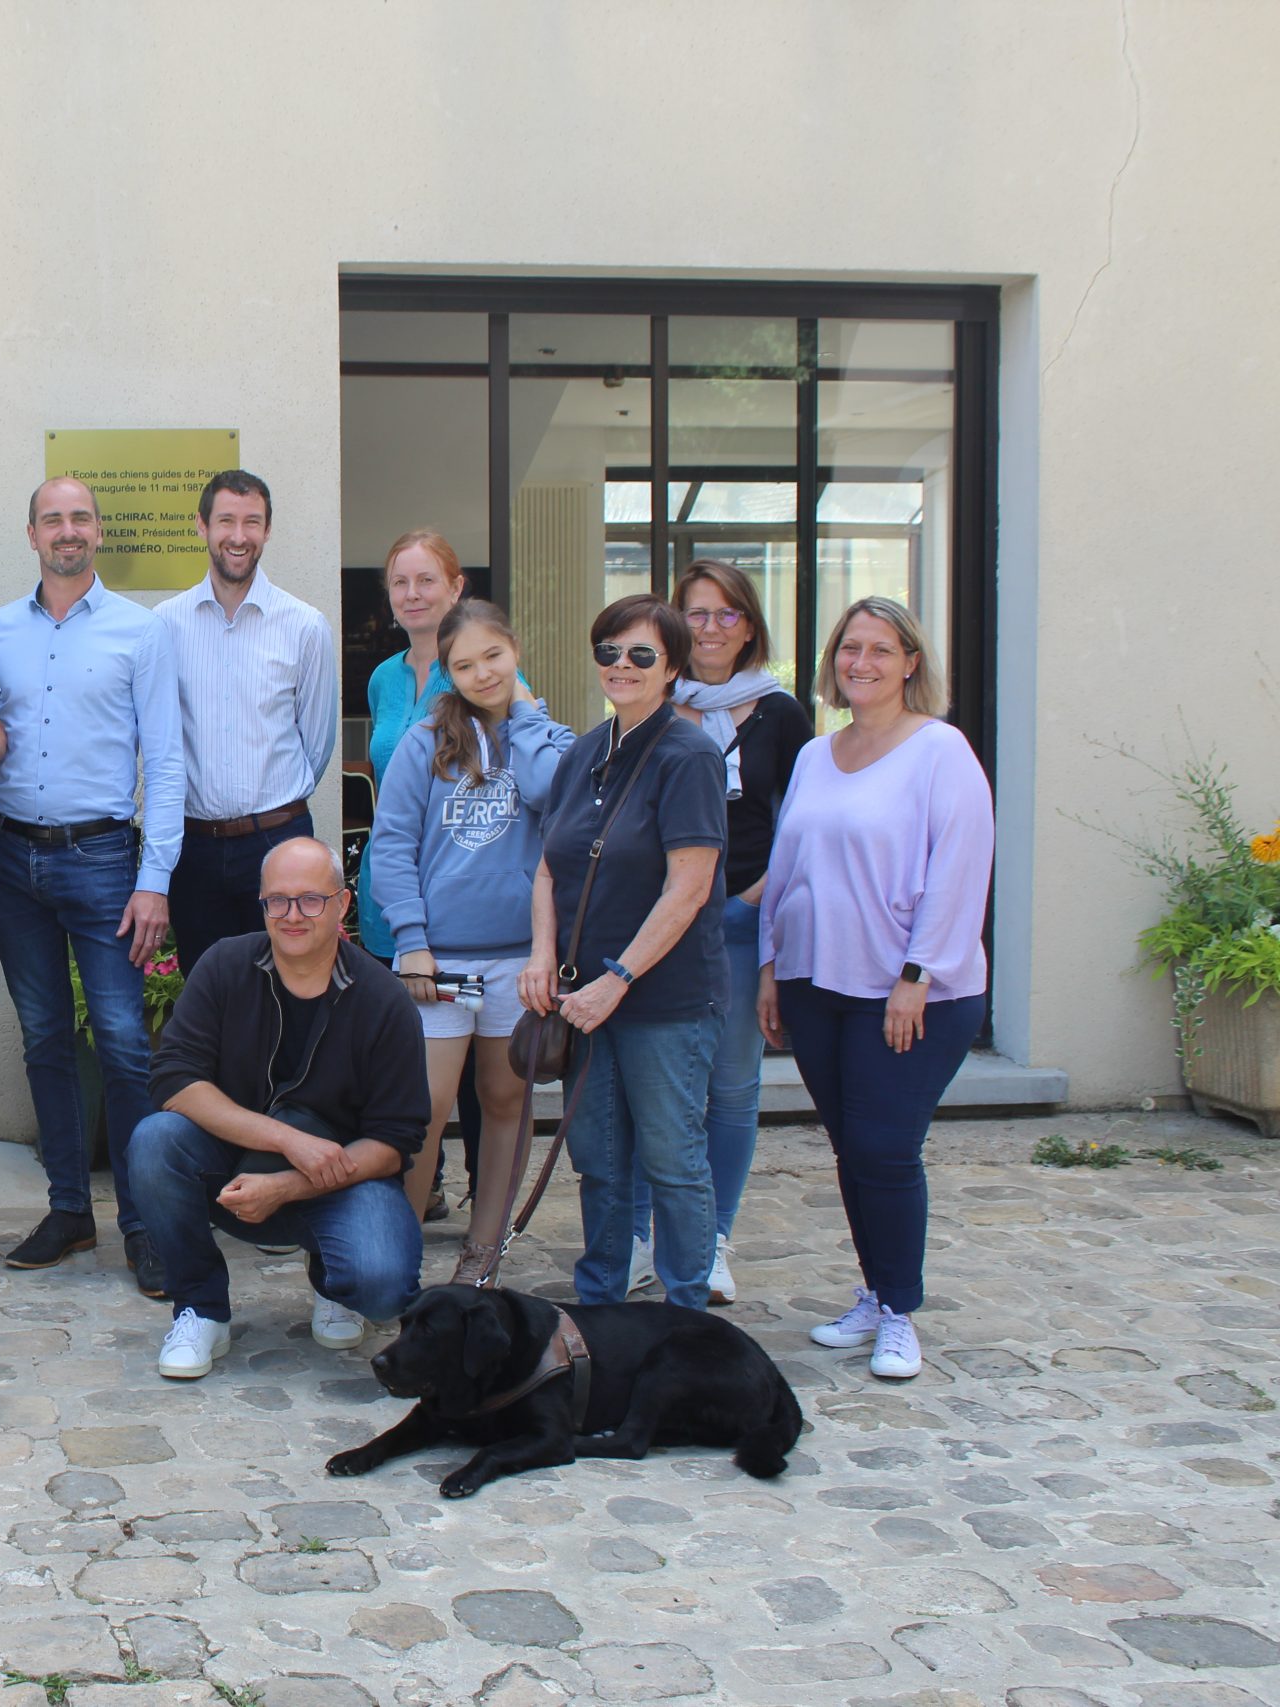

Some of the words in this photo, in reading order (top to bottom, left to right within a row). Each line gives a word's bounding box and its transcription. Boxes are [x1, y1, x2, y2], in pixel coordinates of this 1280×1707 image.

[100, 470, 117, 479] des
[120, 470, 149, 479] chiens
[152, 470, 181, 481] guides
[184, 470, 195, 478] de
[138, 484, 146, 492] le
[150, 484, 159, 492] 11
[163, 484, 179, 492] mai
[182, 483, 203, 492] 1987
[115, 513, 157, 522] CHIRAC,
[160, 513, 185, 521] Maire
[106, 529, 140, 538] KLEIN,
[142, 528, 186, 537] Président
[116, 543, 164, 554] ROMÉRO,
[167, 544, 208, 553] Directeur
[441, 800, 466, 825] LE
